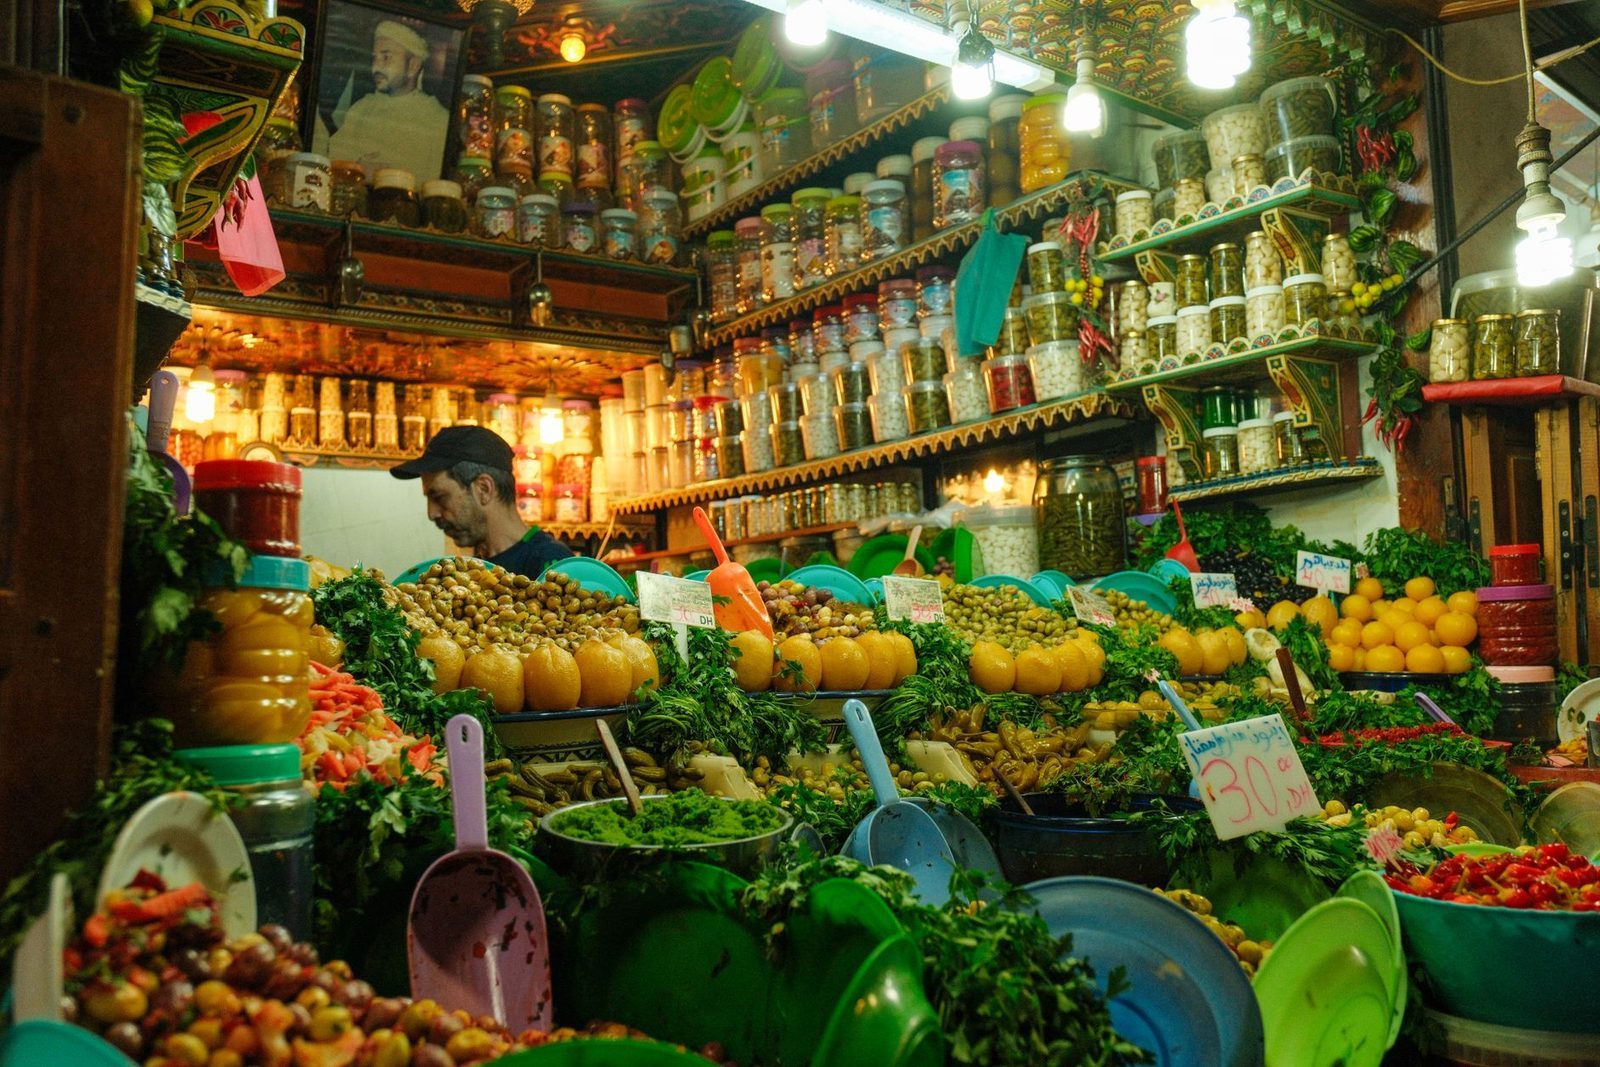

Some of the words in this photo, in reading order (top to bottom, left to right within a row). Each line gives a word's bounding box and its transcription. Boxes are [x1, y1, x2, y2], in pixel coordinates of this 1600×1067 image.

[699, 615, 713, 626] DH
[1250, 717, 1290, 752] زيتون
[1201, 755, 1279, 825] 30
